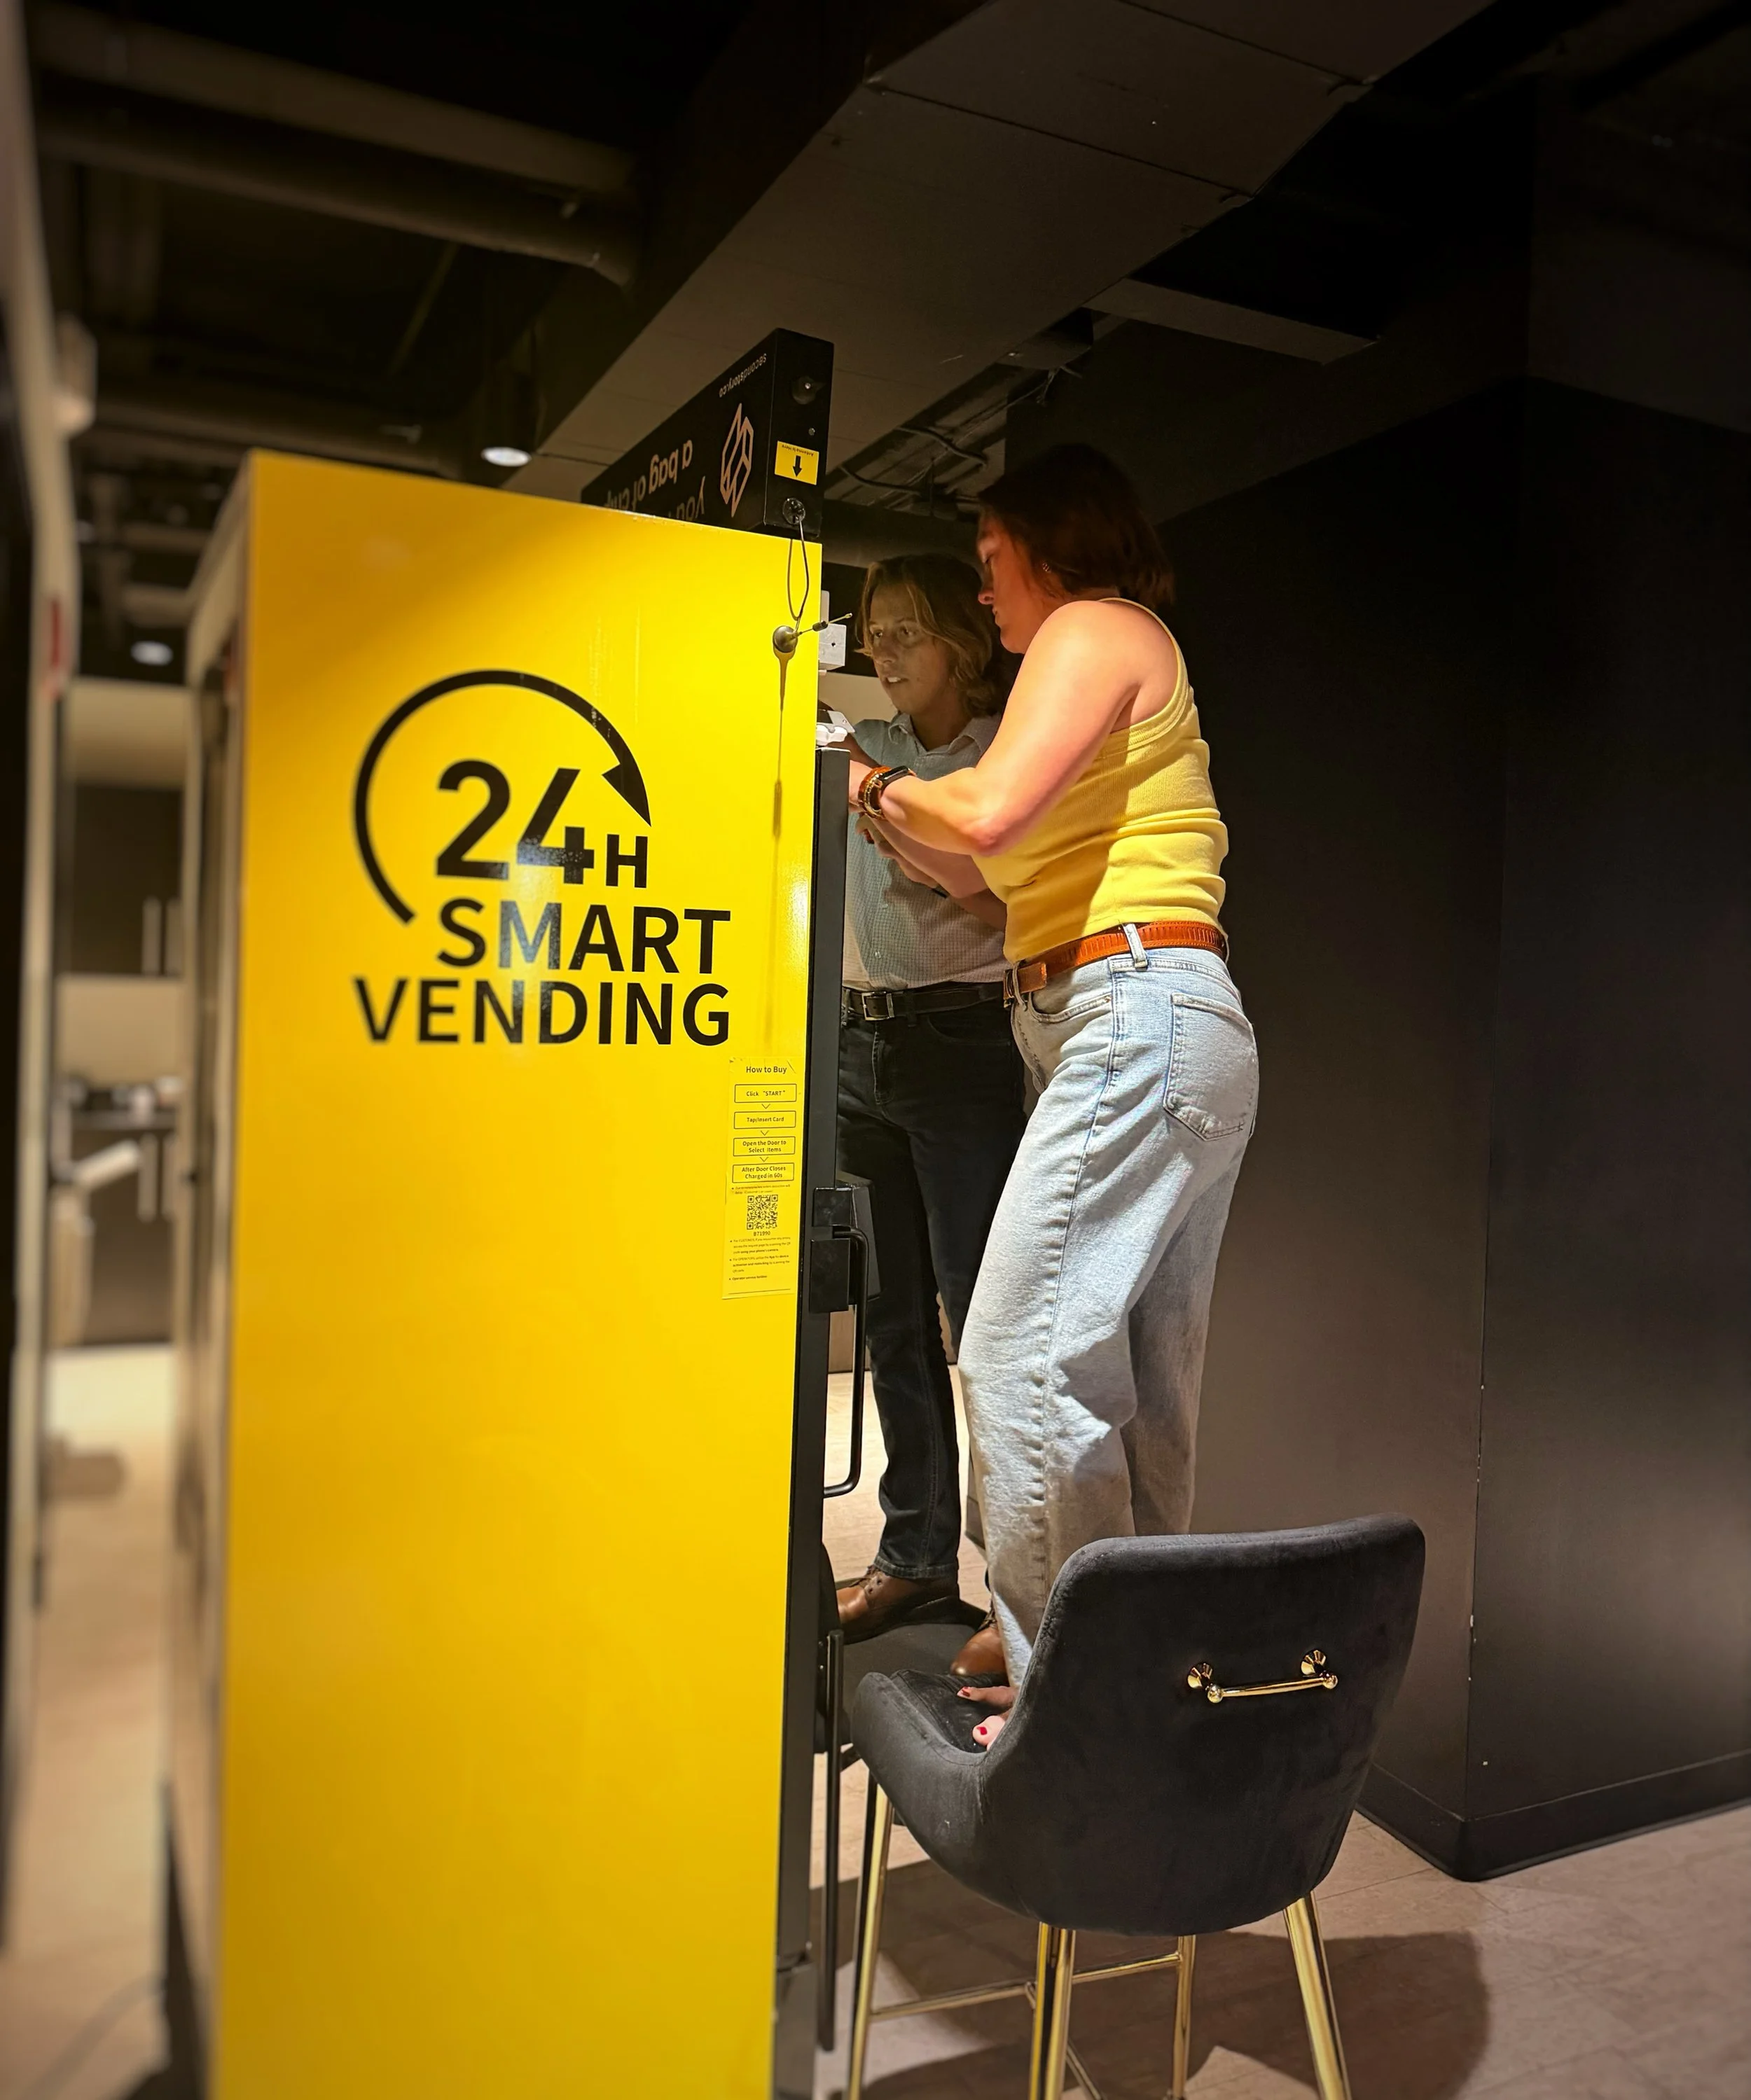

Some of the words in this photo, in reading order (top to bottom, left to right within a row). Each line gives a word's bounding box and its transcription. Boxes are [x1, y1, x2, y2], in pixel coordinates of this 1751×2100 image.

[649, 449, 679, 495] bag
[682, 439, 693, 470] a
[436, 896, 731, 975] SMART
[352, 975, 730, 1047] VENDING
[773, 1066, 787, 1074] Buy
